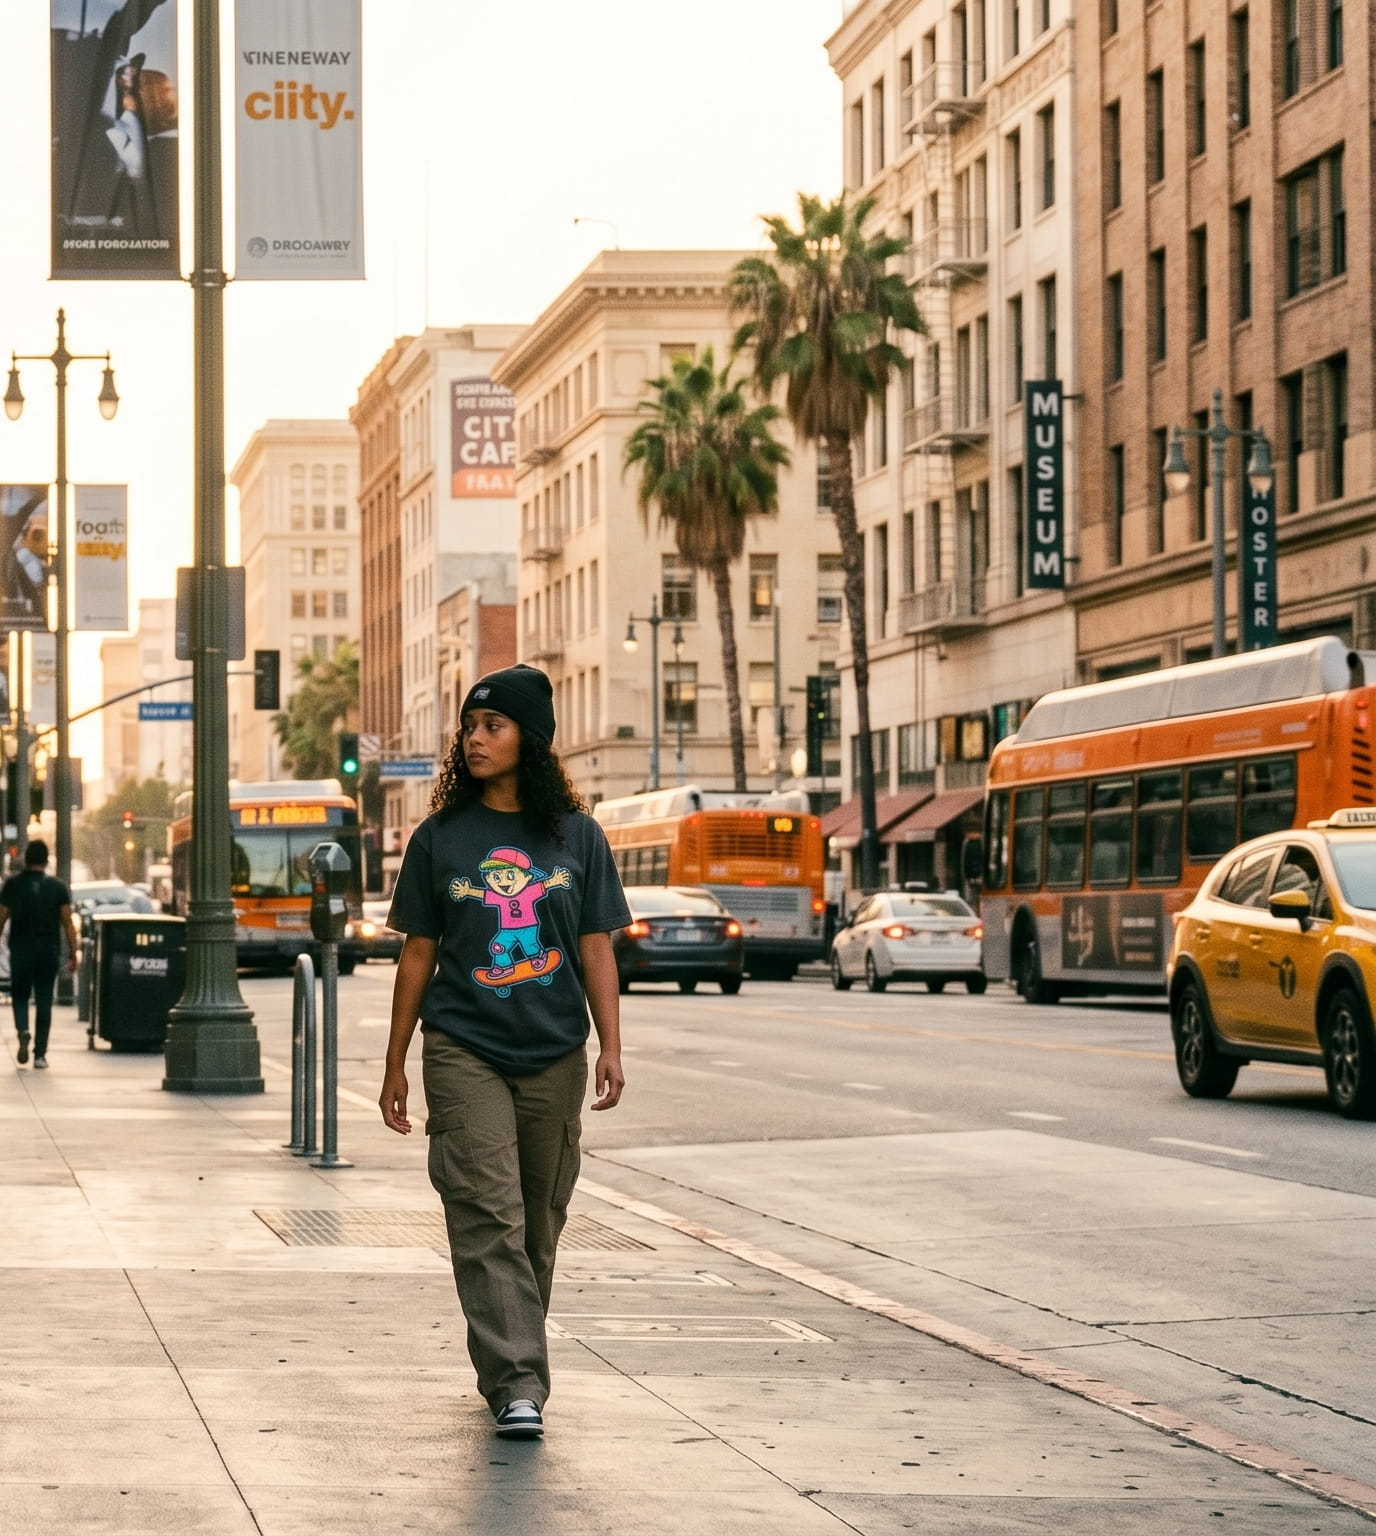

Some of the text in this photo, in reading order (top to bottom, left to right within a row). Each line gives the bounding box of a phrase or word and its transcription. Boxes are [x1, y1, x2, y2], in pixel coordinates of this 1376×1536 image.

[244, 80, 355, 130] ciity.
[463, 415, 516, 439] CIT
[1031, 392, 1062, 576] MUSEUM
